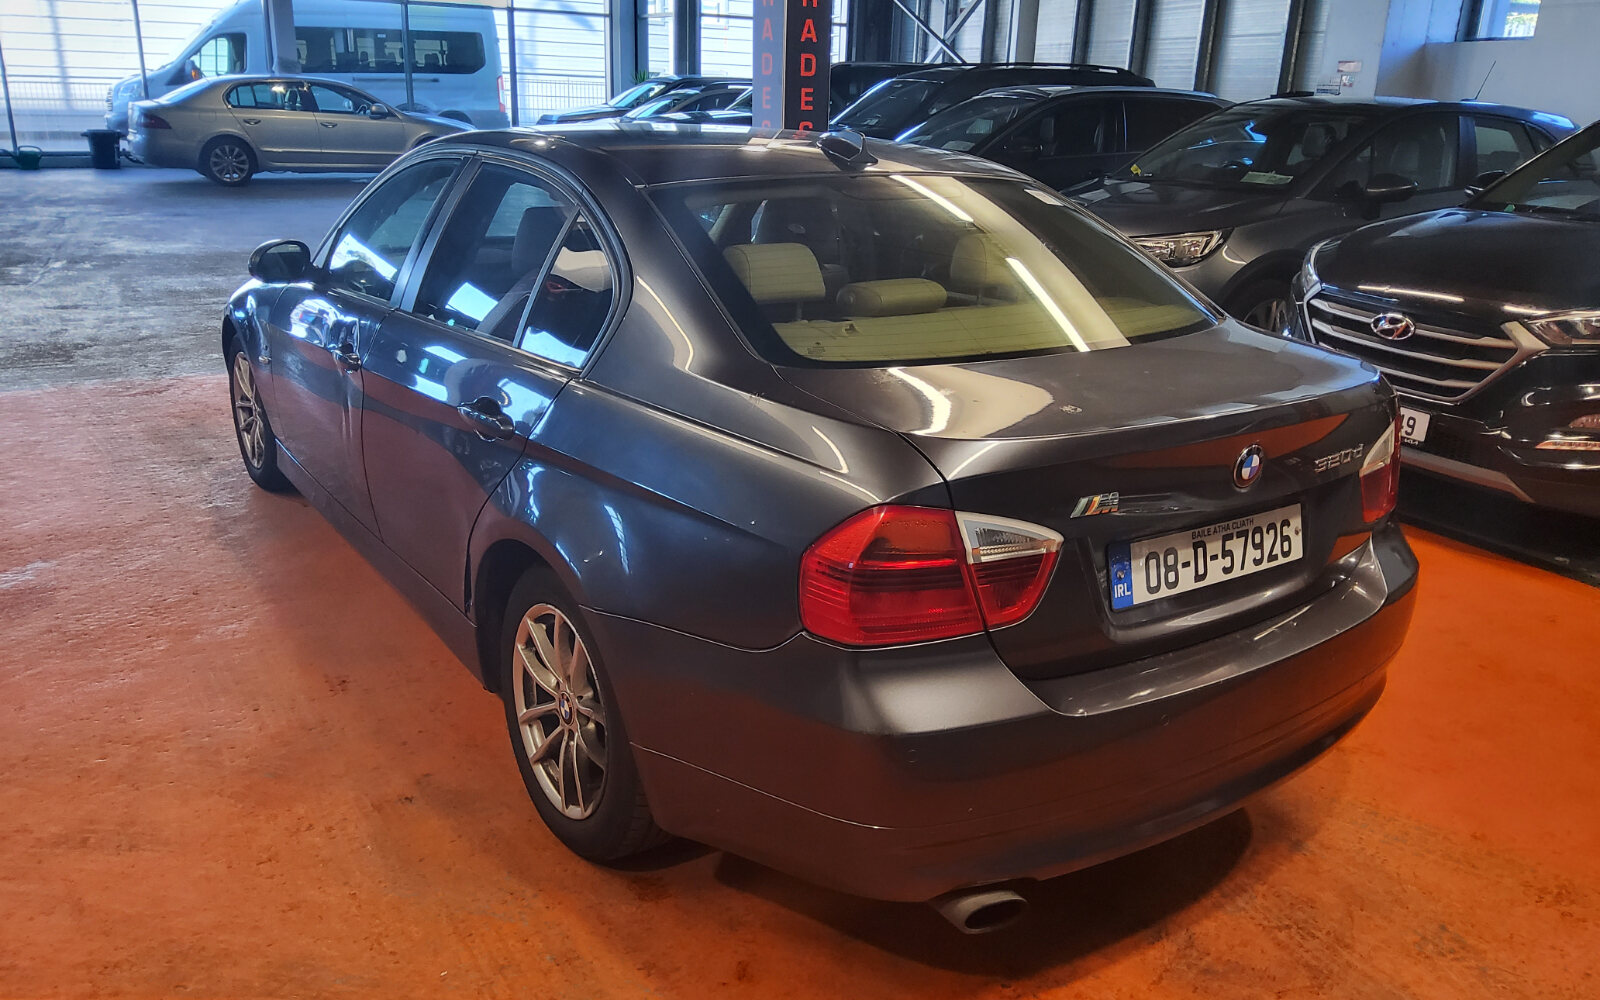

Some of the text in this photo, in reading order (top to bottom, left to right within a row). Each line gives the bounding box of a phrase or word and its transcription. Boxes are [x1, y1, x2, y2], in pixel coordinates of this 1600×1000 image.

[1191, 518, 1254, 540] BAILE ATHA CLIATH
[1145, 519, 1292, 595] 08-D-57926
[1114, 582, 1132, 598] IRL
